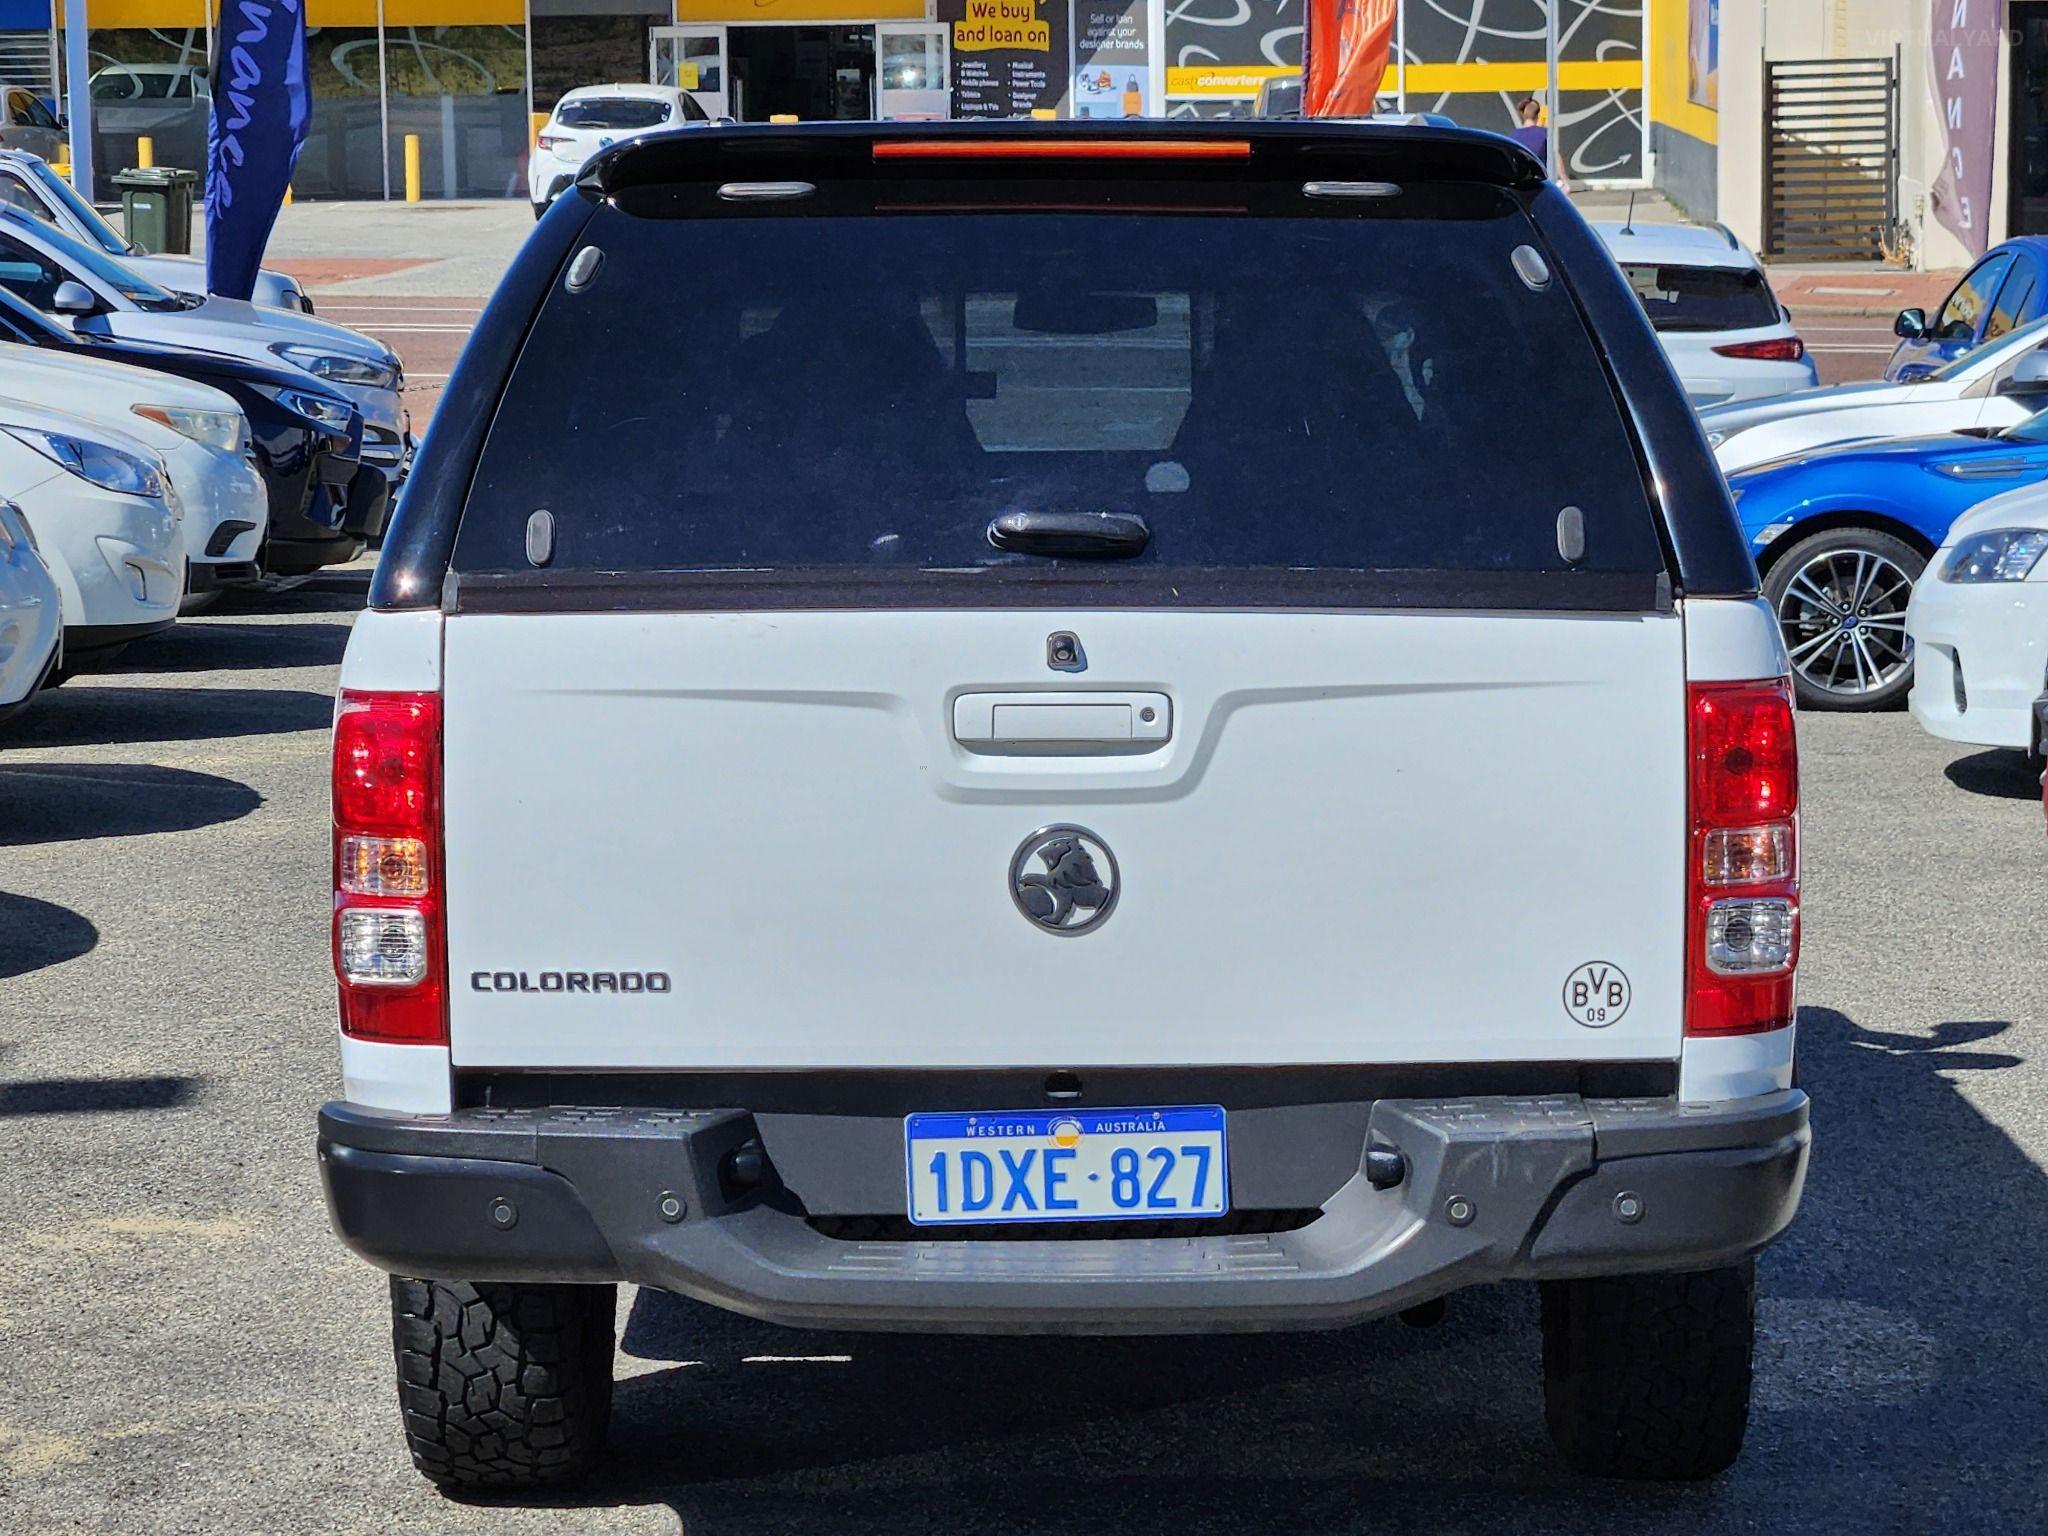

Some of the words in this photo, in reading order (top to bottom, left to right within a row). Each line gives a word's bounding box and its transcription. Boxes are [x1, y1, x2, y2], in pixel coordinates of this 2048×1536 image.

[972, 2, 996, 18] We
[1001, 2, 1030, 23] buy
[1090, 13, 1105, 24] Sell
[1105, 15, 1113, 24] or
[957, 26, 985, 42] and
[990, 26, 1022, 42] loan
[1028, 30, 1047, 42] on
[1117, 29, 1137, 38] your
[1080, 39, 1113, 51] designer
[1115, 39, 1144, 49] brands
[470, 971, 672, 993] COLORADO
[1572, 967, 1623, 1007] BVB
[1587, 1008, 1606, 1022] 09
[965, 1124, 1036, 1137] WESTERN
[1095, 1120, 1166, 1133] AUSTRALIA
